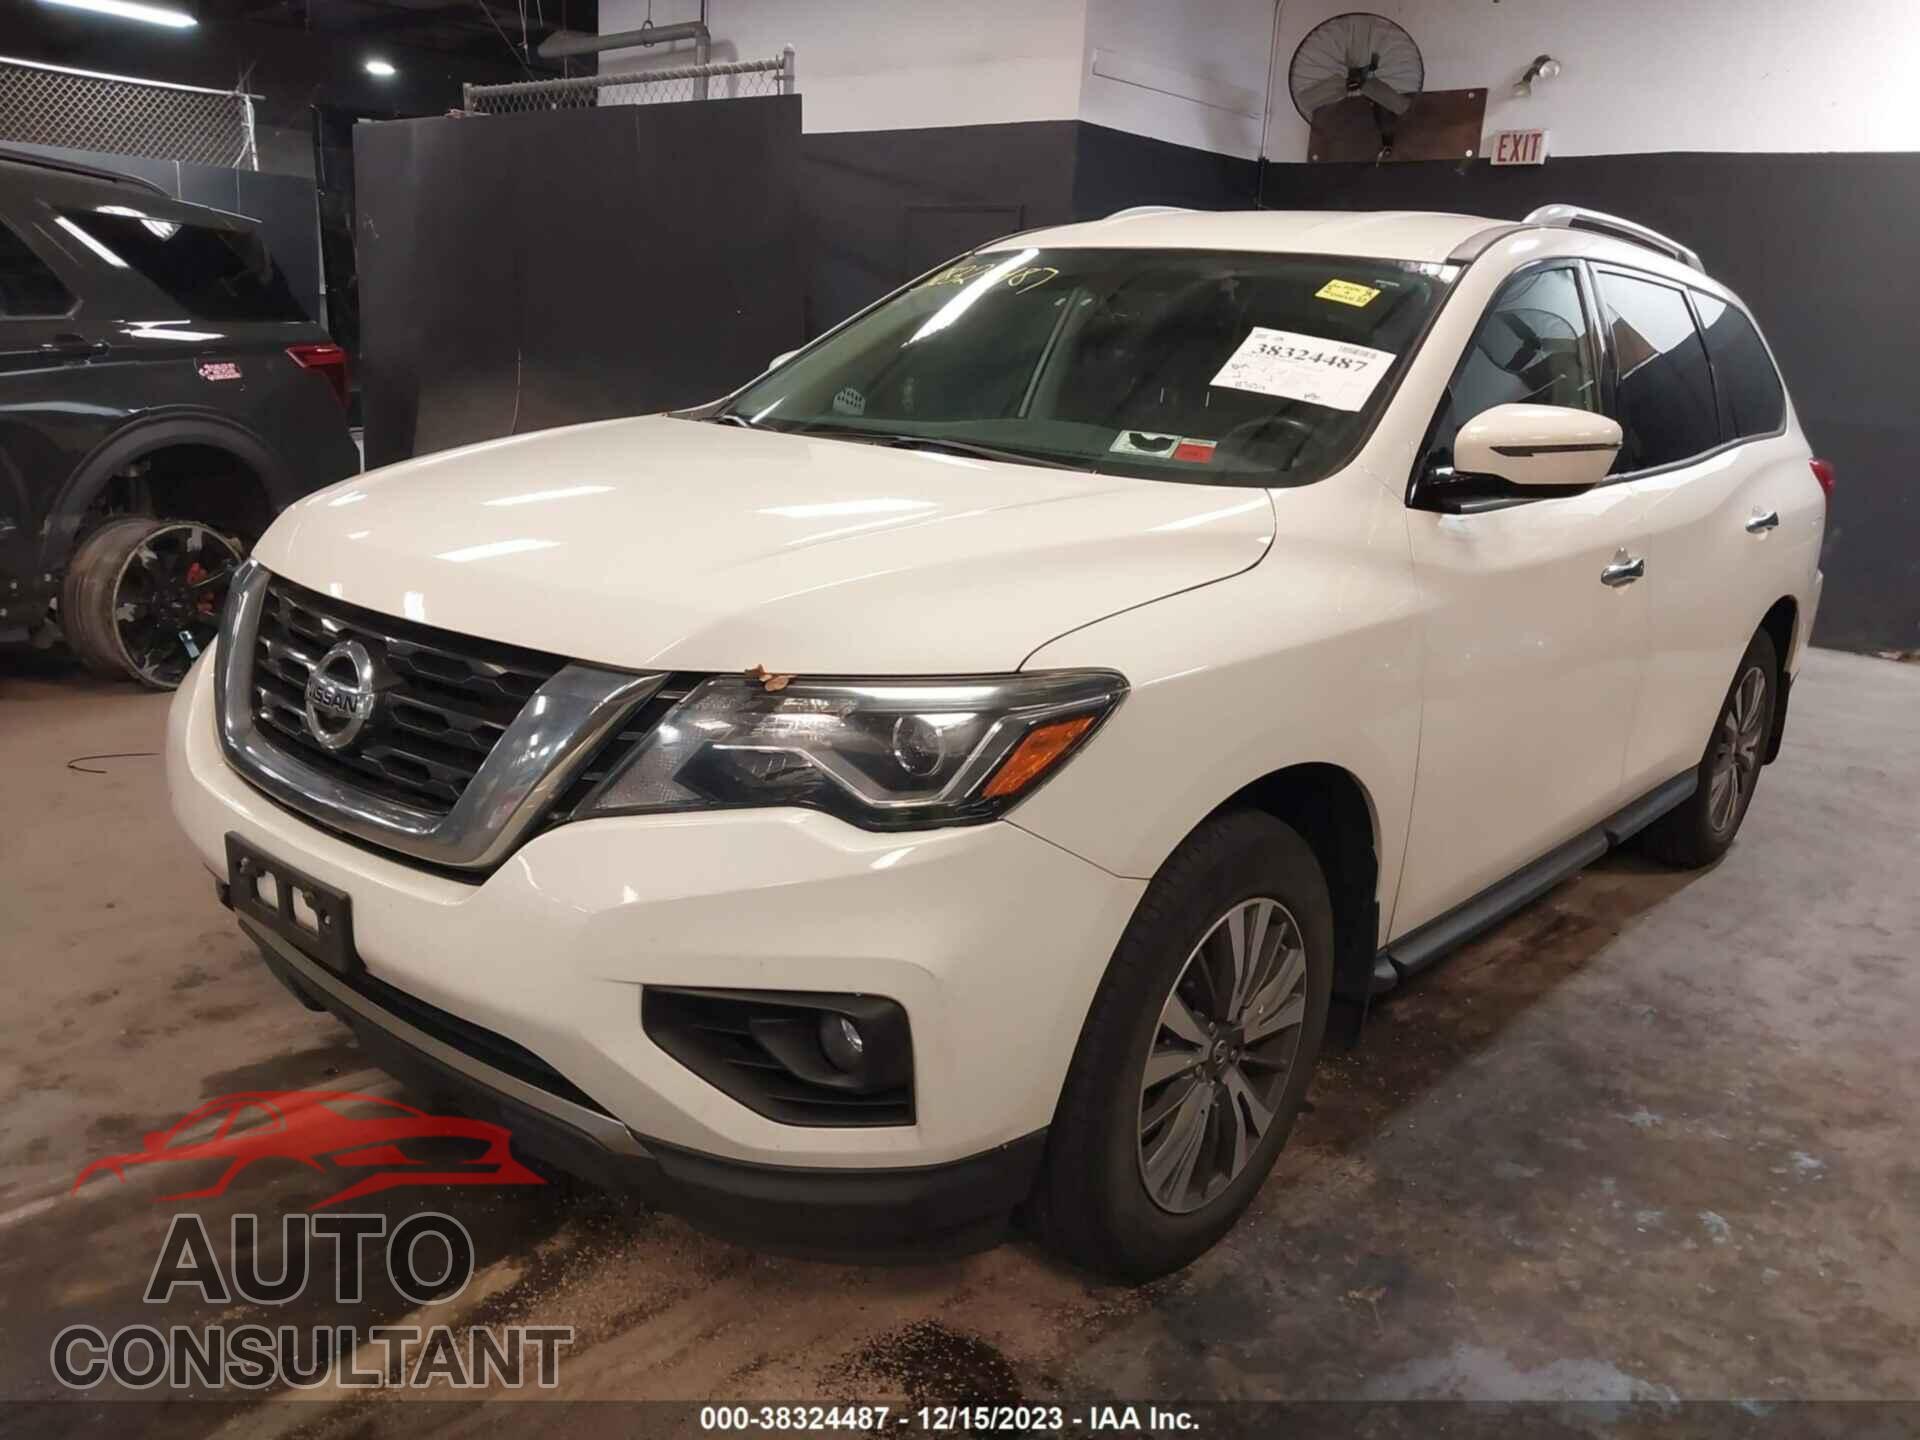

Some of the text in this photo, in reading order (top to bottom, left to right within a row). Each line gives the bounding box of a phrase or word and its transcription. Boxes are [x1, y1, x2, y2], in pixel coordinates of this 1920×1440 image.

[1497, 133, 1542, 162] EXIT
[1251, 343, 1369, 372] 38324487
[305, 682, 358, 713] NISSAN
